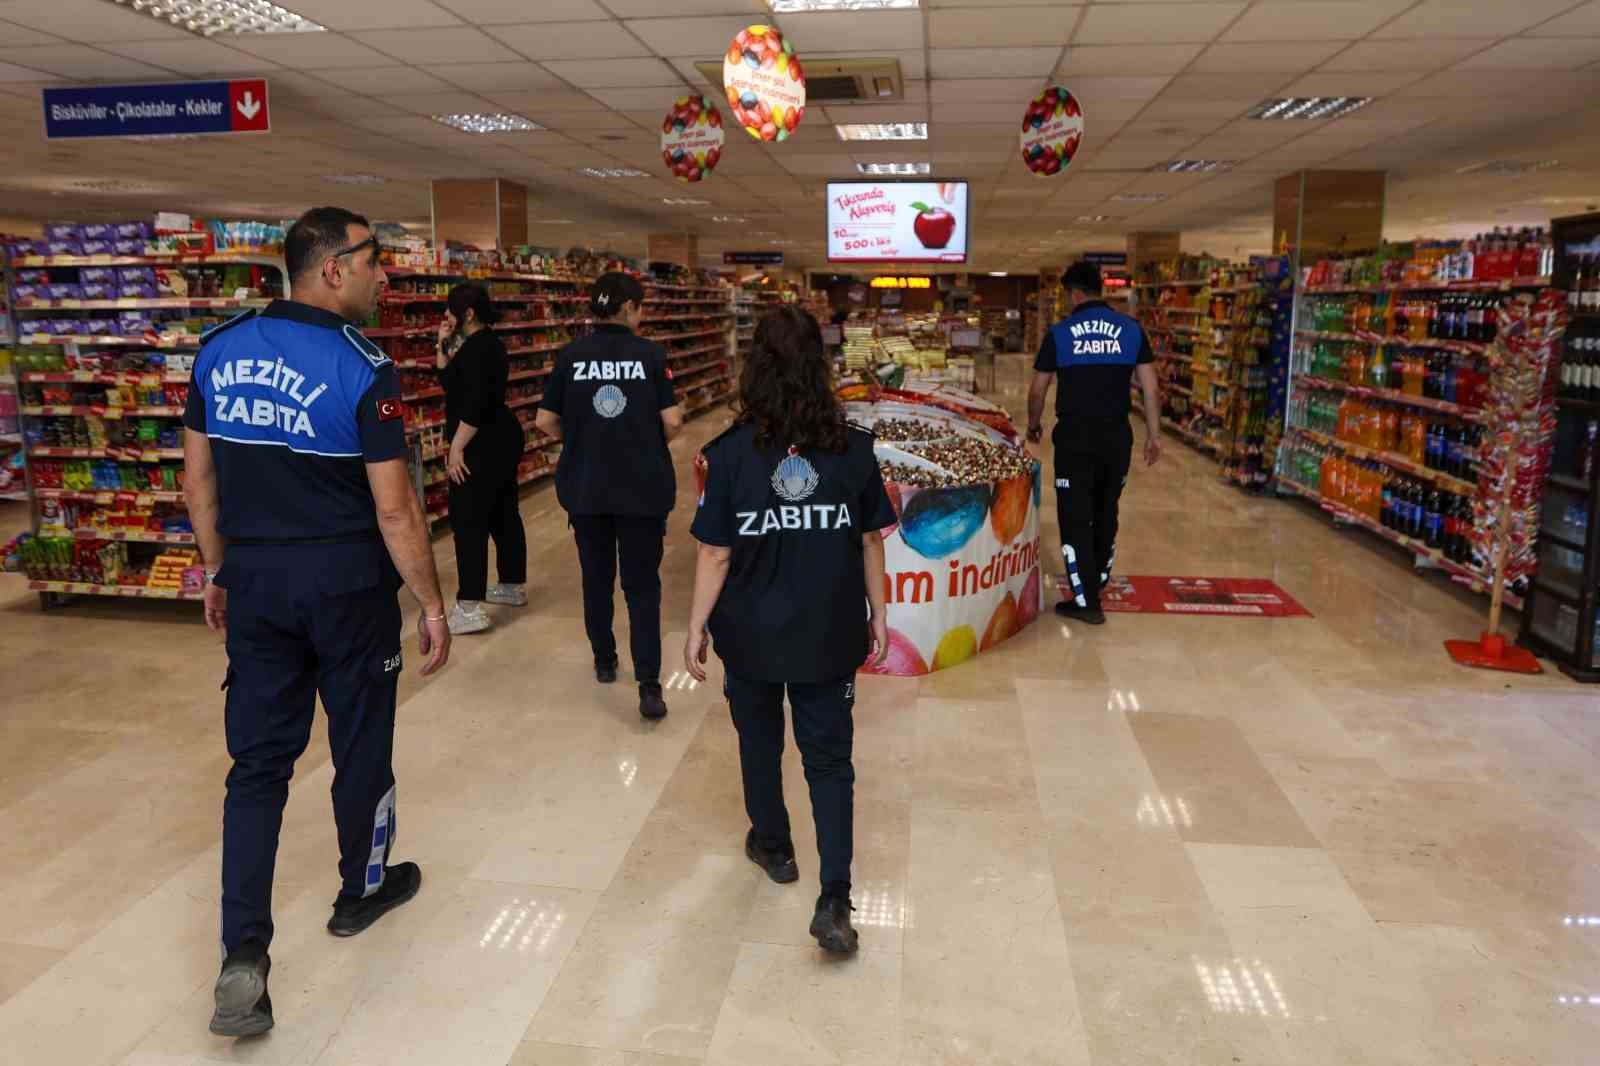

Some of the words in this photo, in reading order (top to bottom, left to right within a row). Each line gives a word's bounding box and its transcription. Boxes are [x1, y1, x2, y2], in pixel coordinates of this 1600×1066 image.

[52, 103, 107, 120] Bisküviler
[116, 101, 177, 122] Çikolatalar
[185, 99, 224, 116] Kekler
[844, 239, 869, 251] 500
[1070, 318, 1123, 340] MEZİTLİ
[1072, 339, 1122, 354] ZABITA
[210, 356, 328, 407] MEZİTLİ
[572, 360, 647, 381] ZABITA
[214, 395, 315, 437] ZABITA
[735, 502, 852, 536] ZABITA
